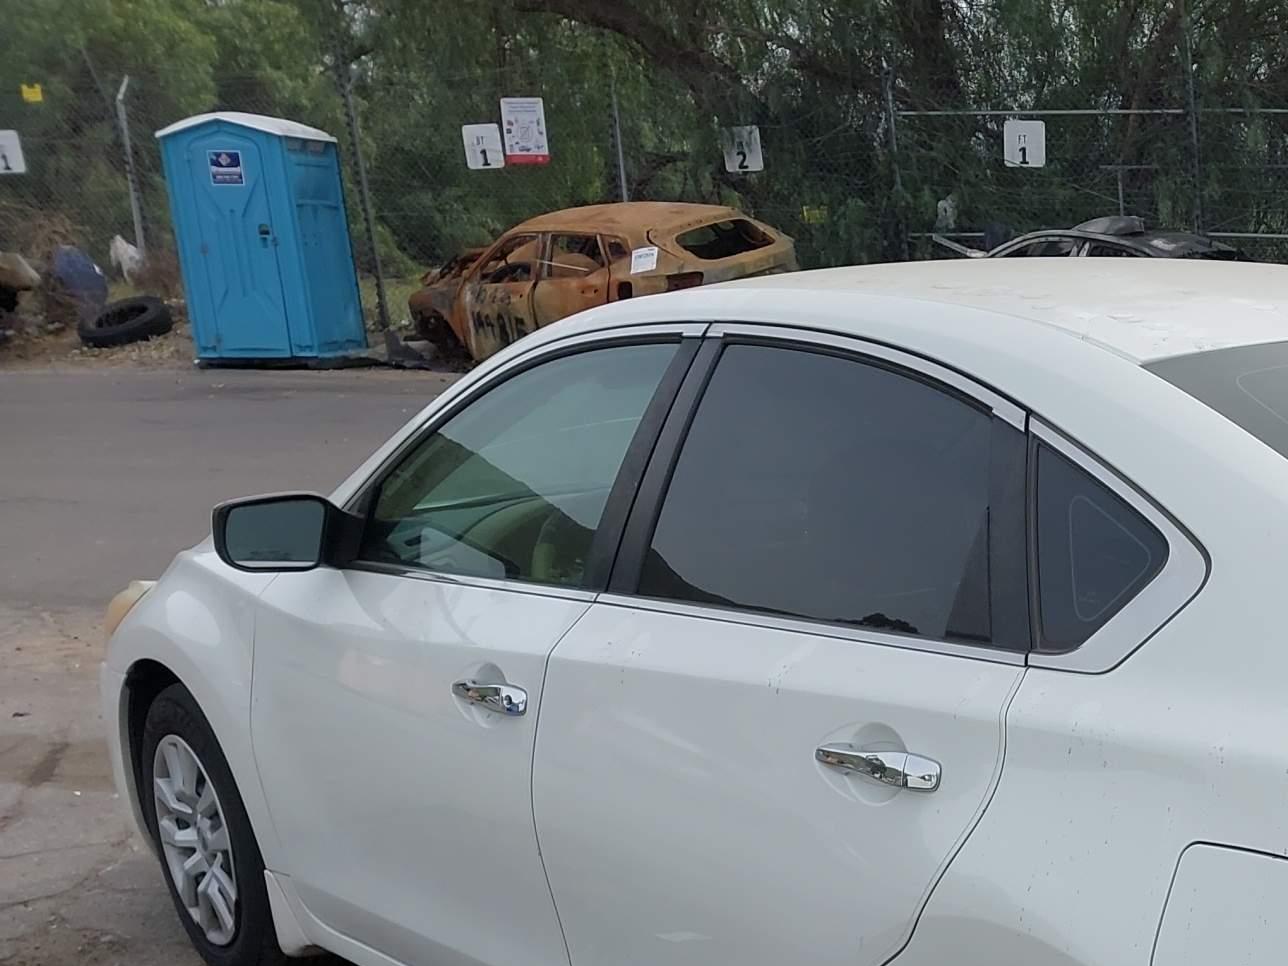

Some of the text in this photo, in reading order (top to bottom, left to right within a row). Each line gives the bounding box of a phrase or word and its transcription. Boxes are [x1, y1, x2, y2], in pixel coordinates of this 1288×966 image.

[480, 148, 491, 166] 1
[736, 150, 749, 169] 2
[1019, 146, 1029, 165] 1
